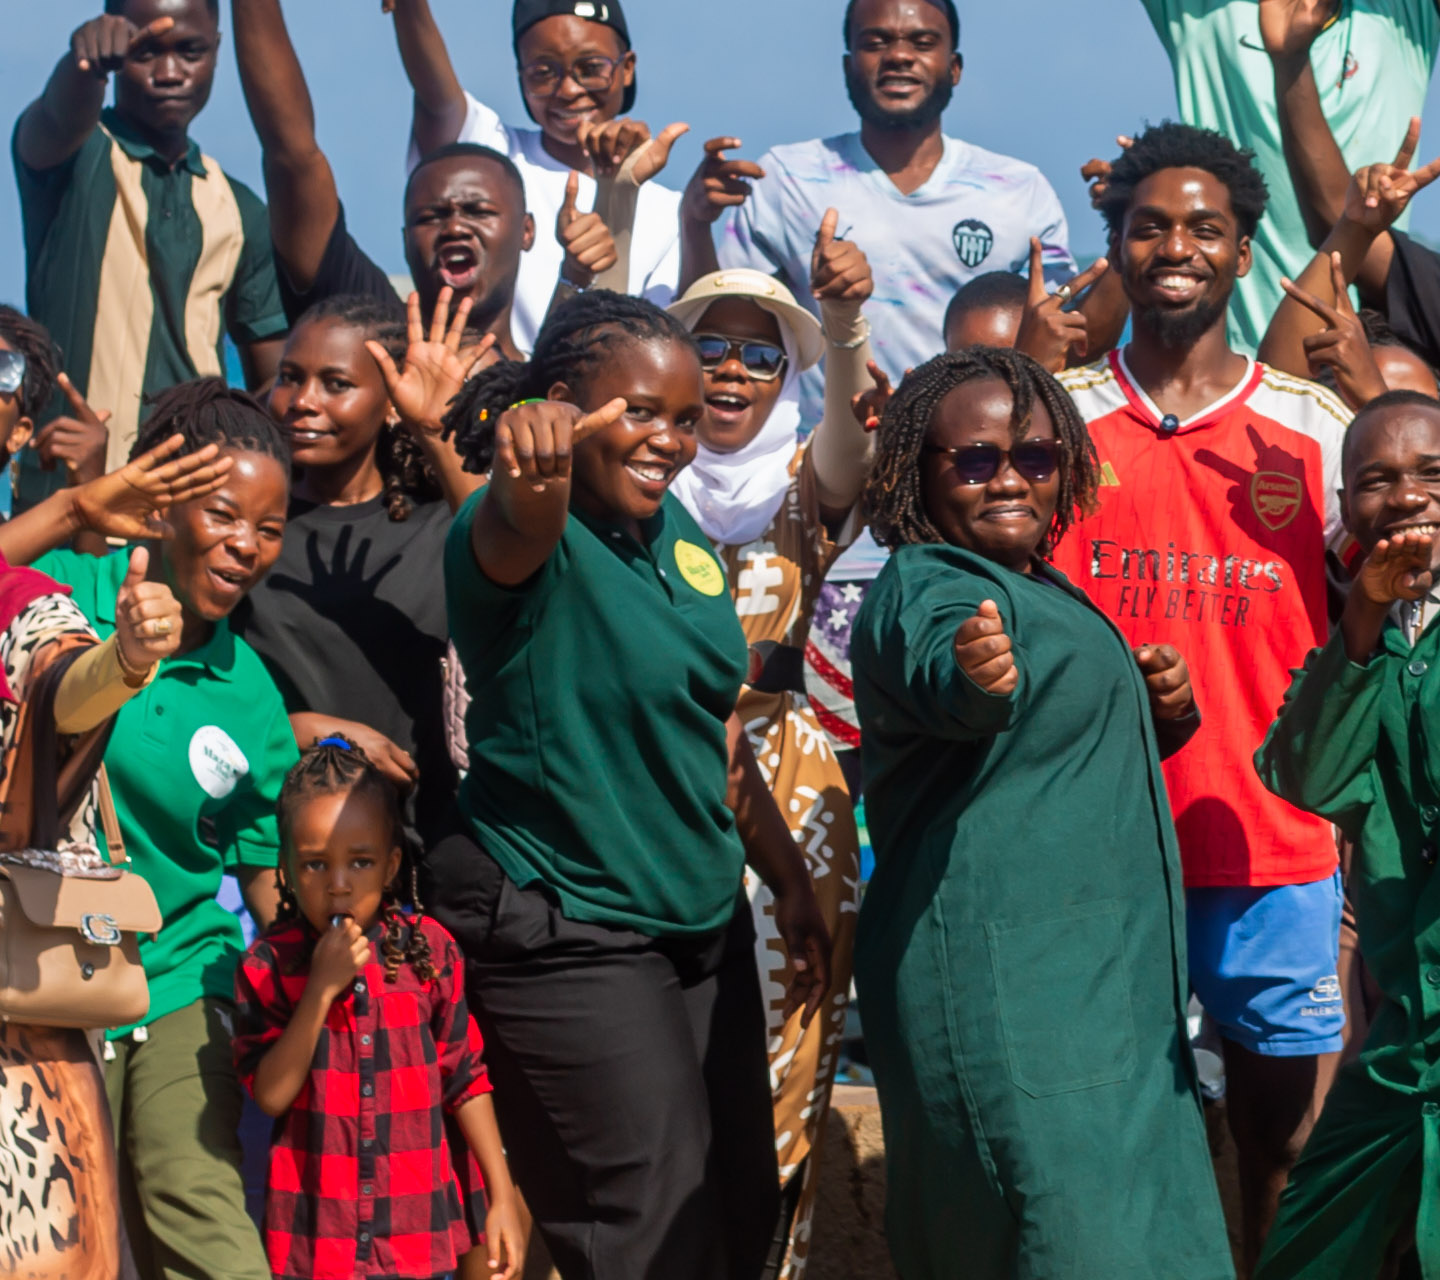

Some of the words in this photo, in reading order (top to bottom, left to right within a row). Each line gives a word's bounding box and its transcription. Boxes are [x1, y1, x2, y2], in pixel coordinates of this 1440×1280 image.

[1090, 539, 1284, 593] Emirates
[1117, 586, 1158, 618] FLY
[1164, 589, 1251, 627] BETTER
